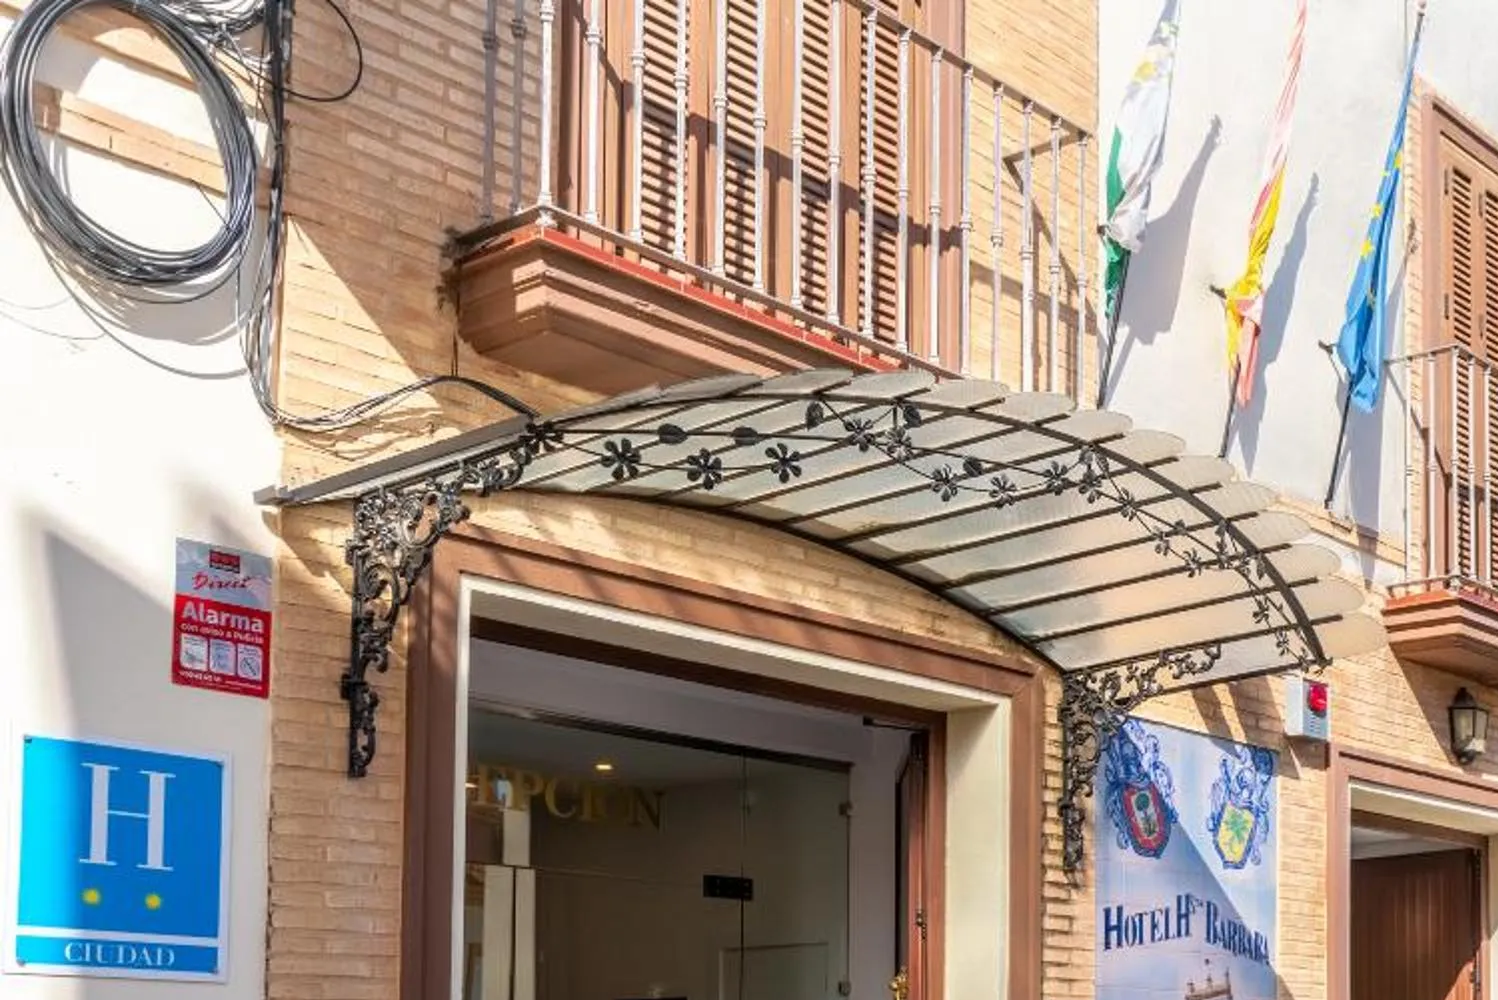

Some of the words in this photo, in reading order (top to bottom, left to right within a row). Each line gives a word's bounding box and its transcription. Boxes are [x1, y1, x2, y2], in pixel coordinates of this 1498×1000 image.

[182, 600, 264, 633] Alarma
[78, 762, 177, 872] H
[65, 941, 176, 967] CIUDAD
